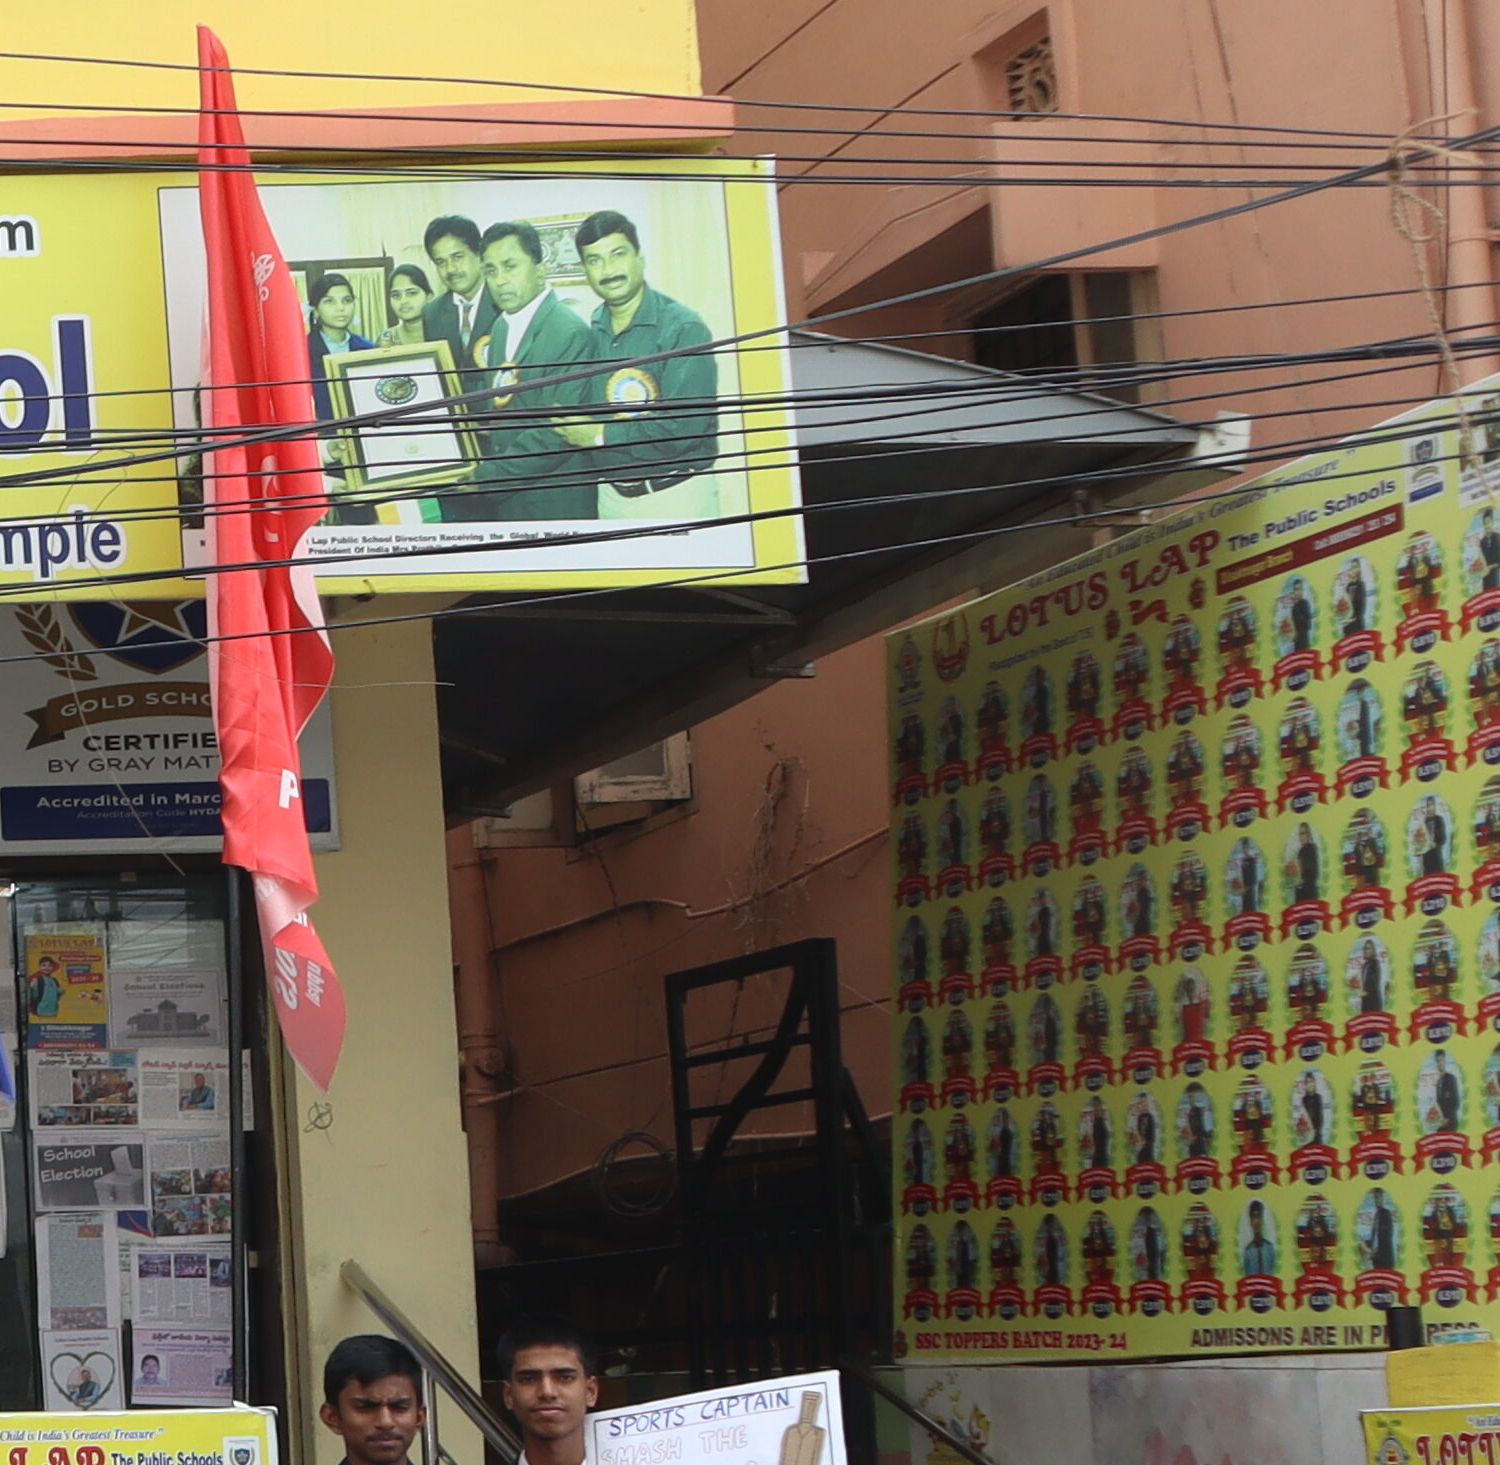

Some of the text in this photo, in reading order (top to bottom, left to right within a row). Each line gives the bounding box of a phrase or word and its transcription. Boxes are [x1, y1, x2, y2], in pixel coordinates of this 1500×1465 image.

[1227, 479, 1396, 553] The Public Schools
[395, 533, 485, 544] Directors Receiving
[981, 571, 1108, 646] LOTUS
[1121, 529, 1220, 594] LAP
[60, 695, 135, 717] GOLD
[49, 757, 152, 773] BY GRAY
[37, 793, 221, 808] Accredited Marc
[944, 1327, 1336, 1349] TOPPERS BATCH ADMISSONS ARE
[609, 1389, 789, 1437] SPORTS CAPTAIN
[699, 1425, 748, 1454] THE
